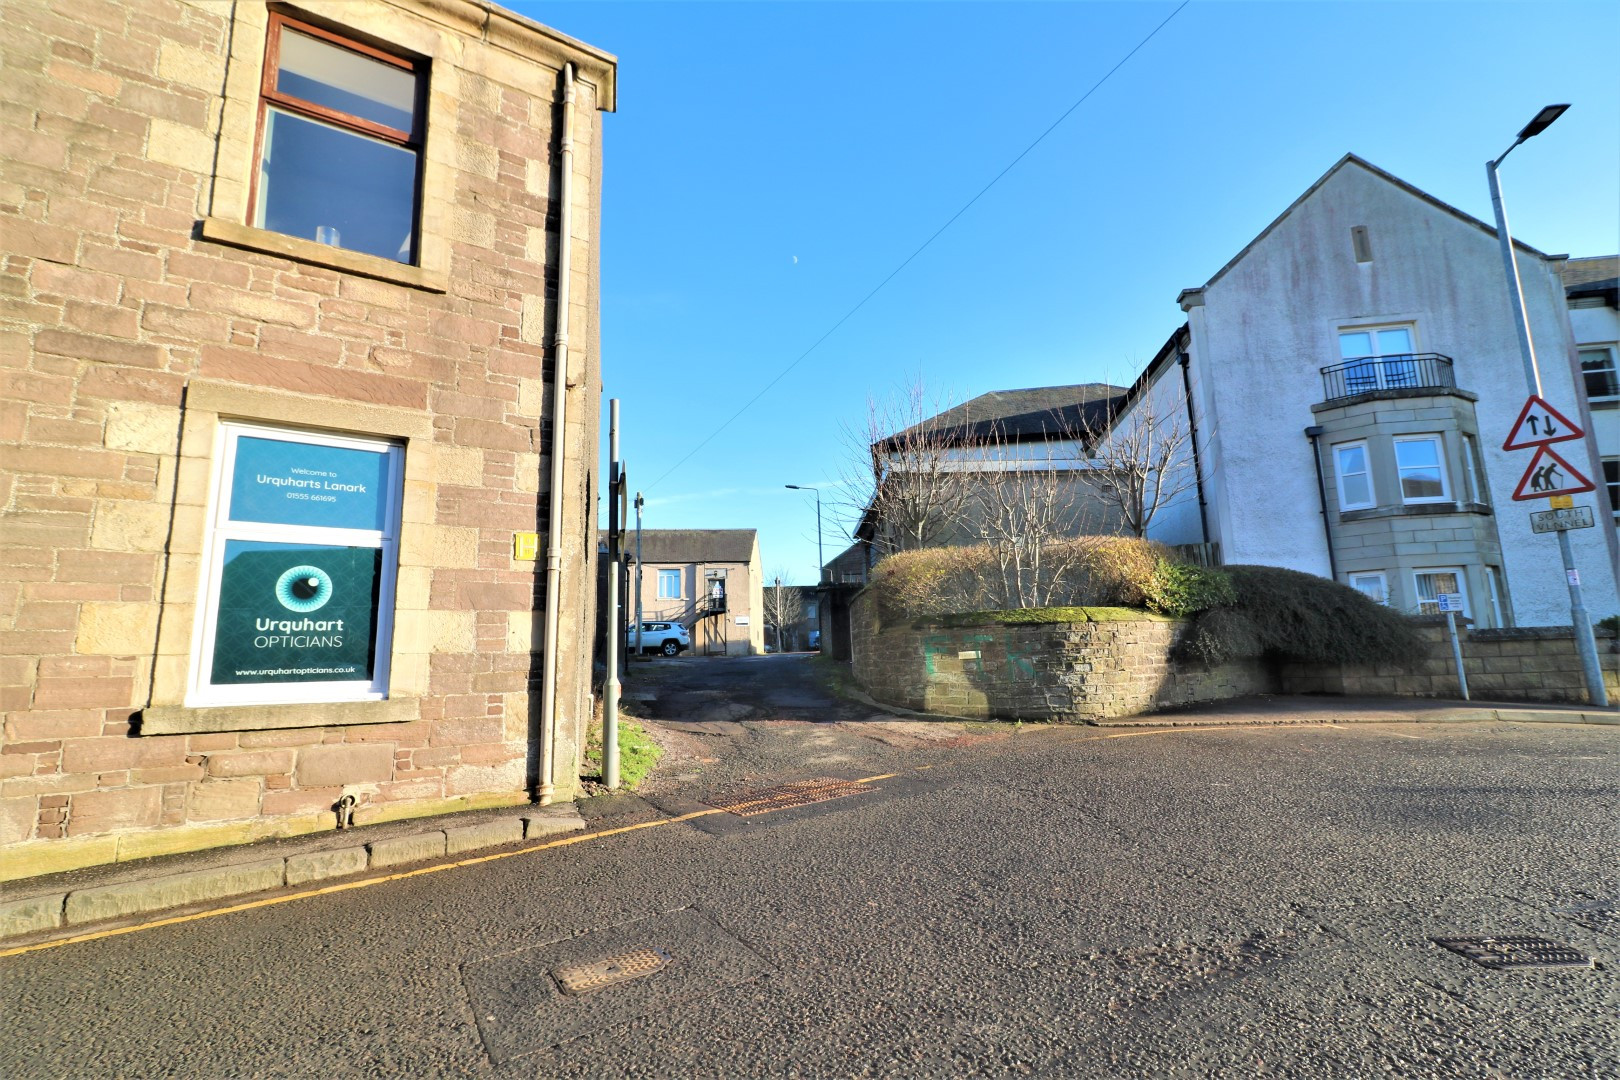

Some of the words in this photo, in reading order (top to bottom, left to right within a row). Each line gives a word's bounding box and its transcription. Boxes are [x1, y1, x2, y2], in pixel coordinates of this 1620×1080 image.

[291, 467, 328, 478] Welcome
[328, 471, 338, 479] to
[256, 474, 322, 489] Urquharts
[324, 480, 367, 494] Lanark
[286, 492, 309, 501] 01555
[310, 494, 337, 503] 661695
[1538, 508, 1584, 522] SOUTH
[255, 617, 344, 634] Urquhart
[254, 635, 343, 649] OPTICIANS
[235, 666, 356, 677] www.urquhartopticians.co.uk
